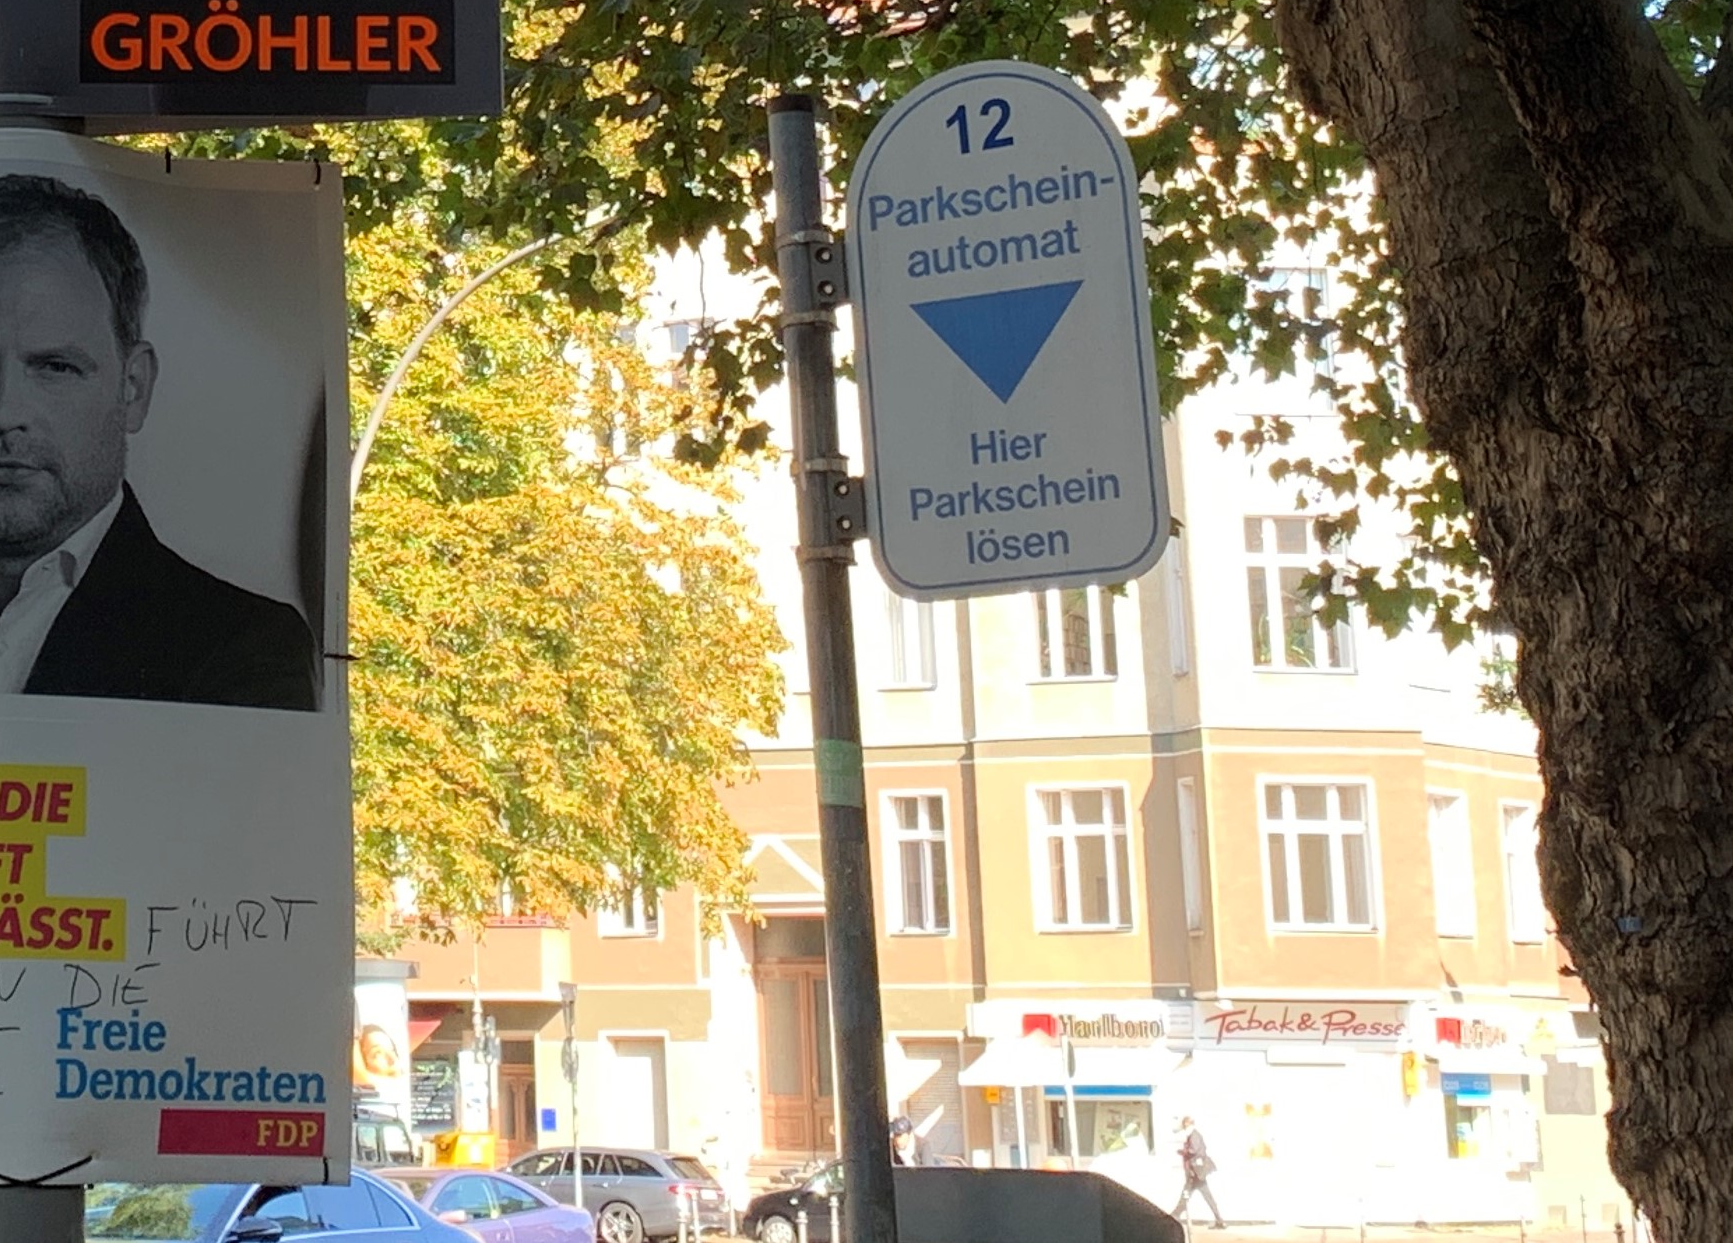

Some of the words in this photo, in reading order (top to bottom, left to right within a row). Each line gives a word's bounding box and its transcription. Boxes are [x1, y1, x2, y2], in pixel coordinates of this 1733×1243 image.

[89, 0, 442, 73] GRÖHLER
[946, 98, 1015, 154] 12
[869, 165, 1115, 231] Parkschein-
[907, 219, 1081, 278] automat
[971, 429, 1047, 466] Hier
[909, 470, 1120, 522] Parkschein
[967, 526, 1070, 564] lösen
[145, 895, 318, 955] FÜHRT
[66, 962, 161, 1010] DIE
[56, 1007, 166, 1051] Freie
[55, 1058, 326, 1104] Demokraten
[255, 1119, 319, 1148] FDP
